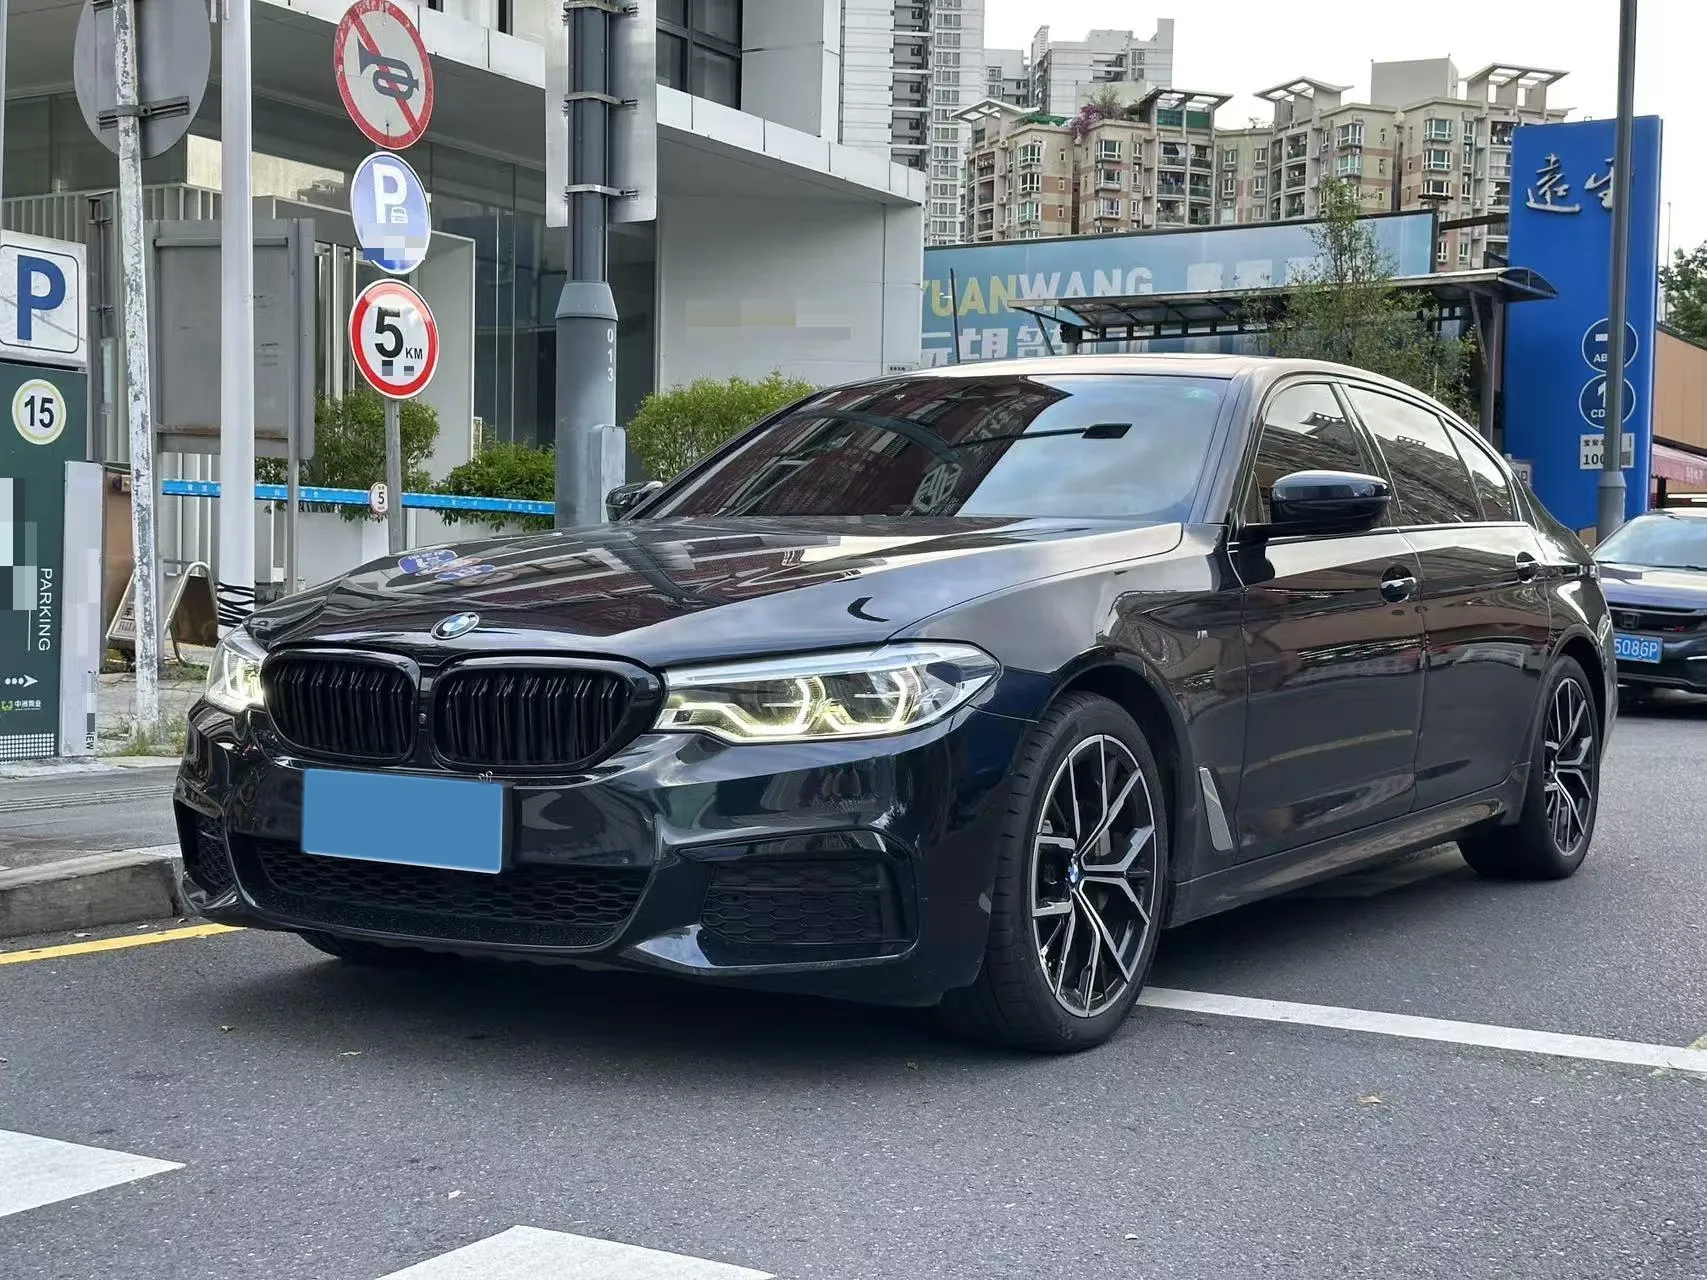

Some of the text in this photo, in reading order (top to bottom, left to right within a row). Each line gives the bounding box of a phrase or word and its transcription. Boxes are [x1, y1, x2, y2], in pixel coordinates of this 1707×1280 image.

[373, 162, 407, 224] P
[17, 254, 66, 341] P
[375, 306, 423, 360] 5 KM
[1593, 353, 1608, 363] AB
[24, 395, 54, 428] 15
[38, 568, 53, 651] PARKING
